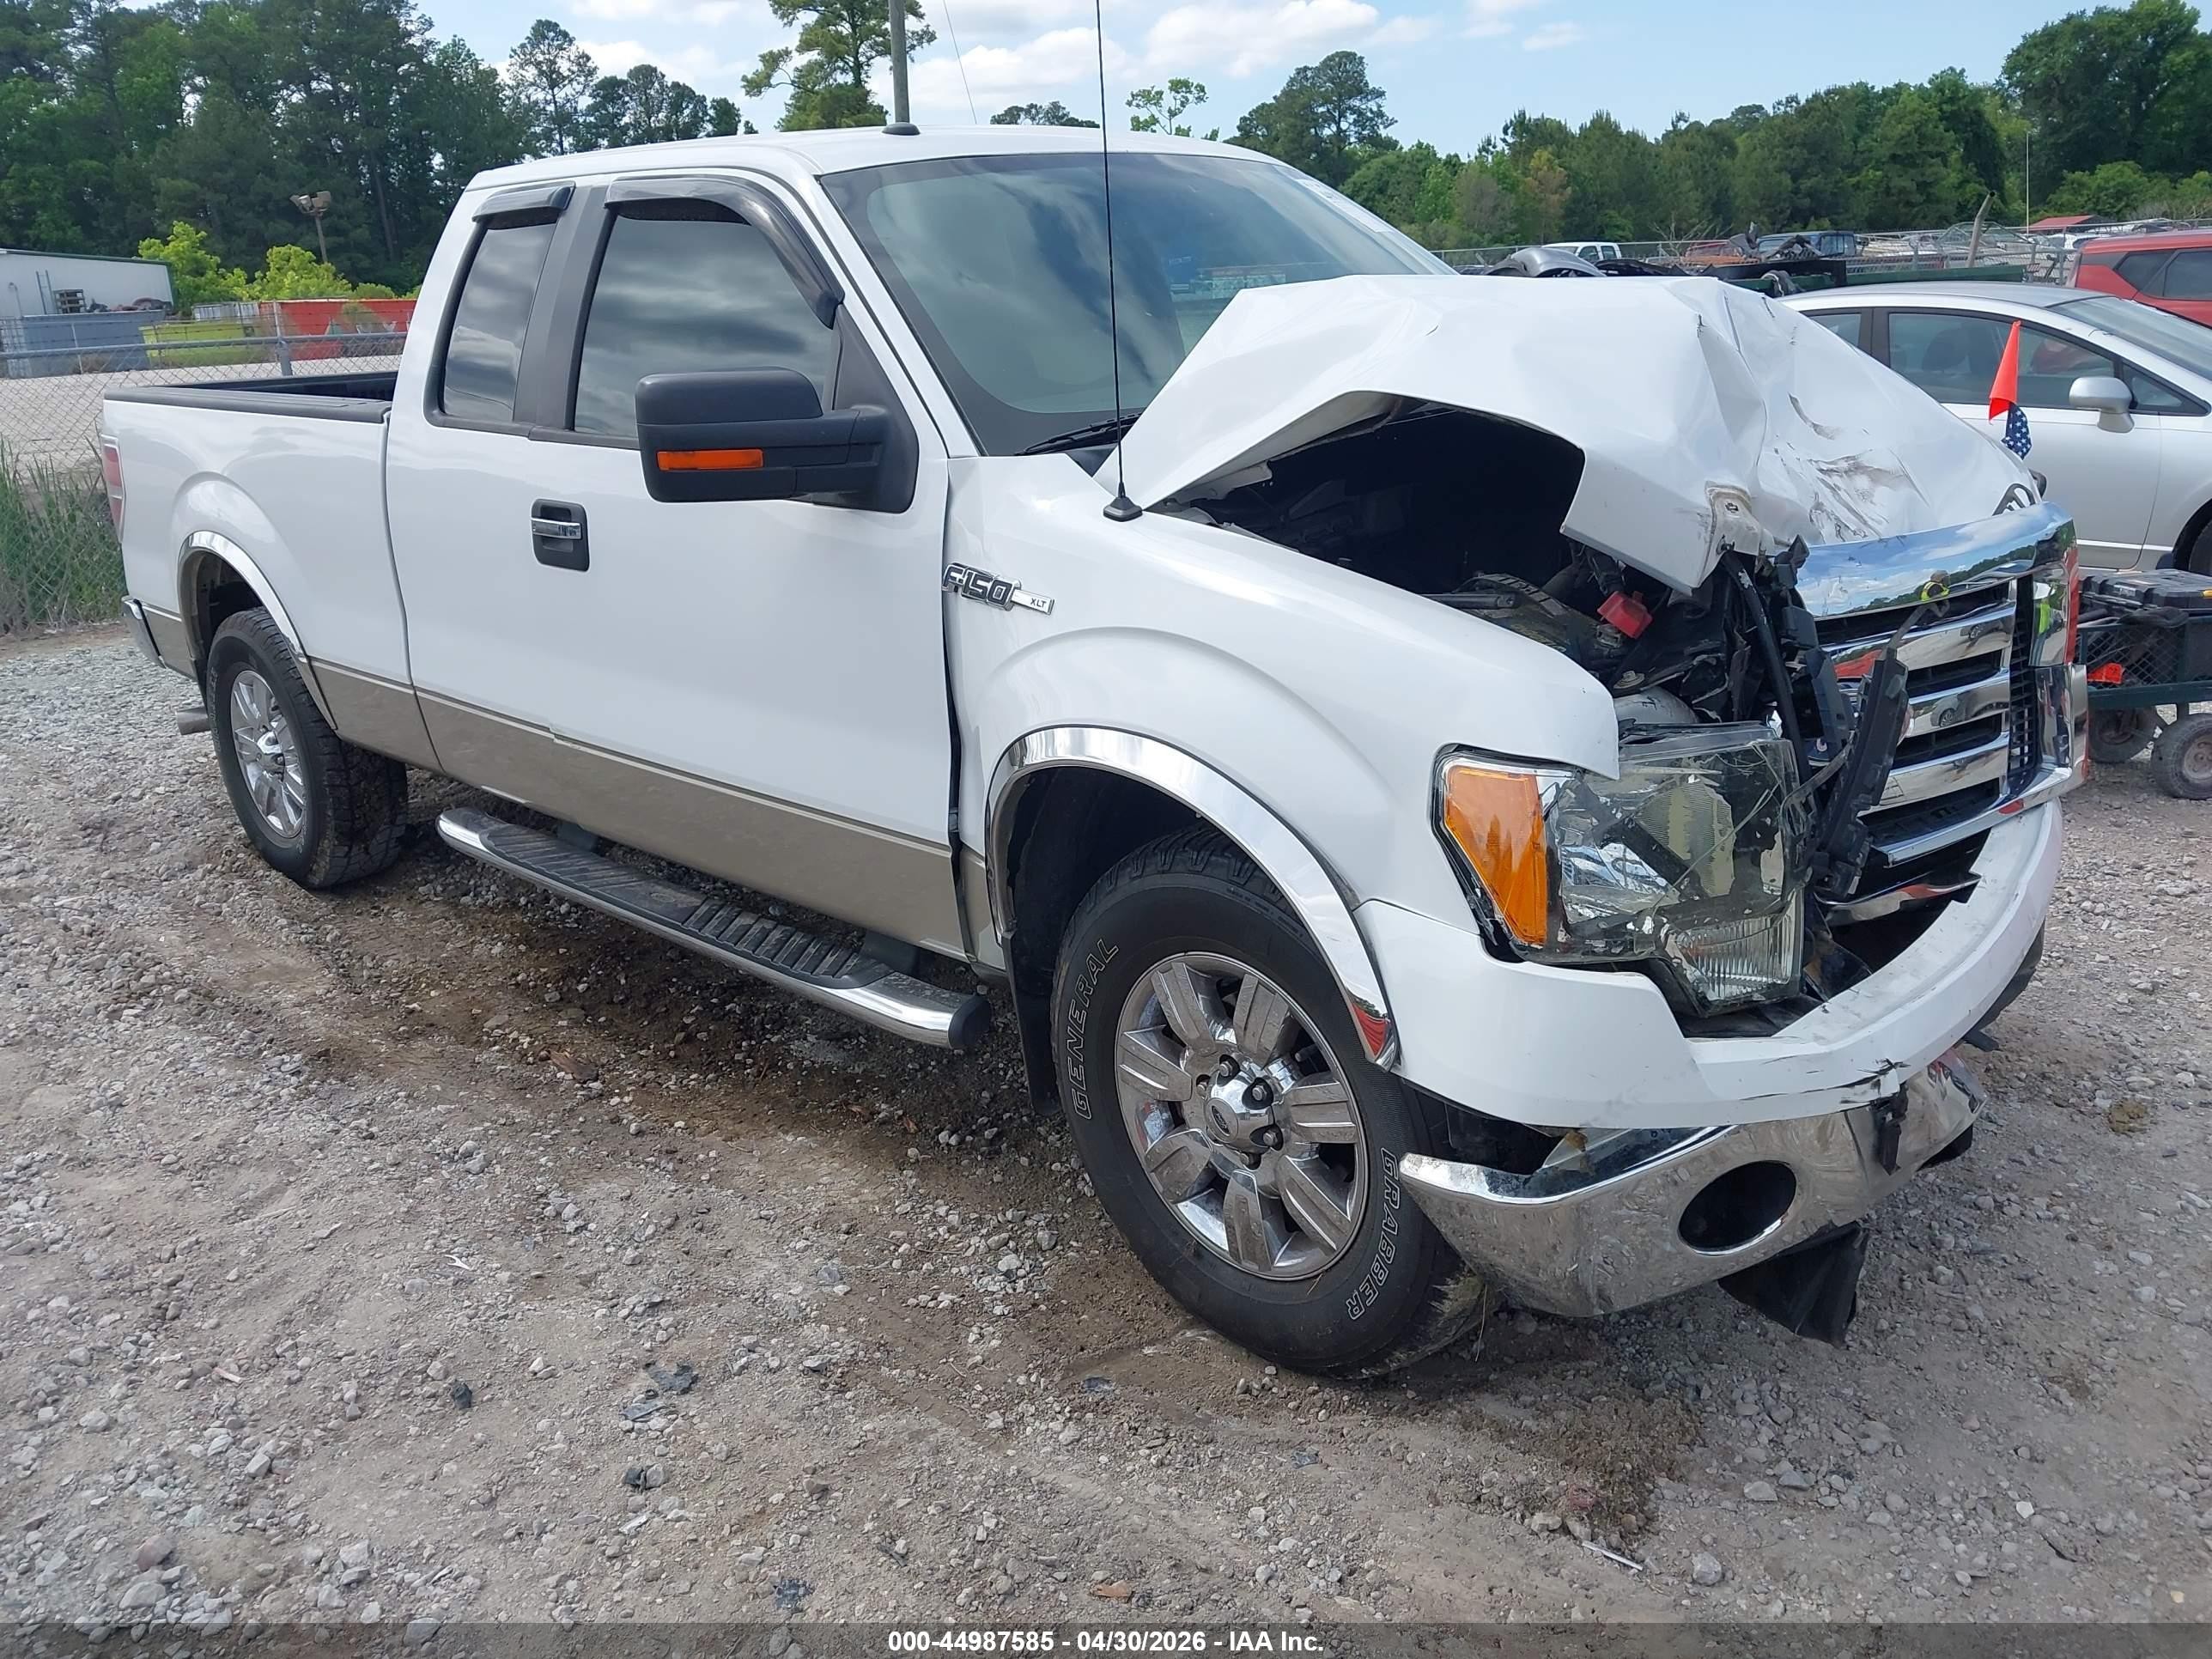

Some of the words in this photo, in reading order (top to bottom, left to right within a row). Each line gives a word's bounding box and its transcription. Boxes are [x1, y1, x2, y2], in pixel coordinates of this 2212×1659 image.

[941, 562, 1018, 610] F-150
[1030, 597, 1048, 609] XLT
[1066, 938, 1120, 1120] GENERAL
[1346, 1147, 1401, 1321] GRABBER
